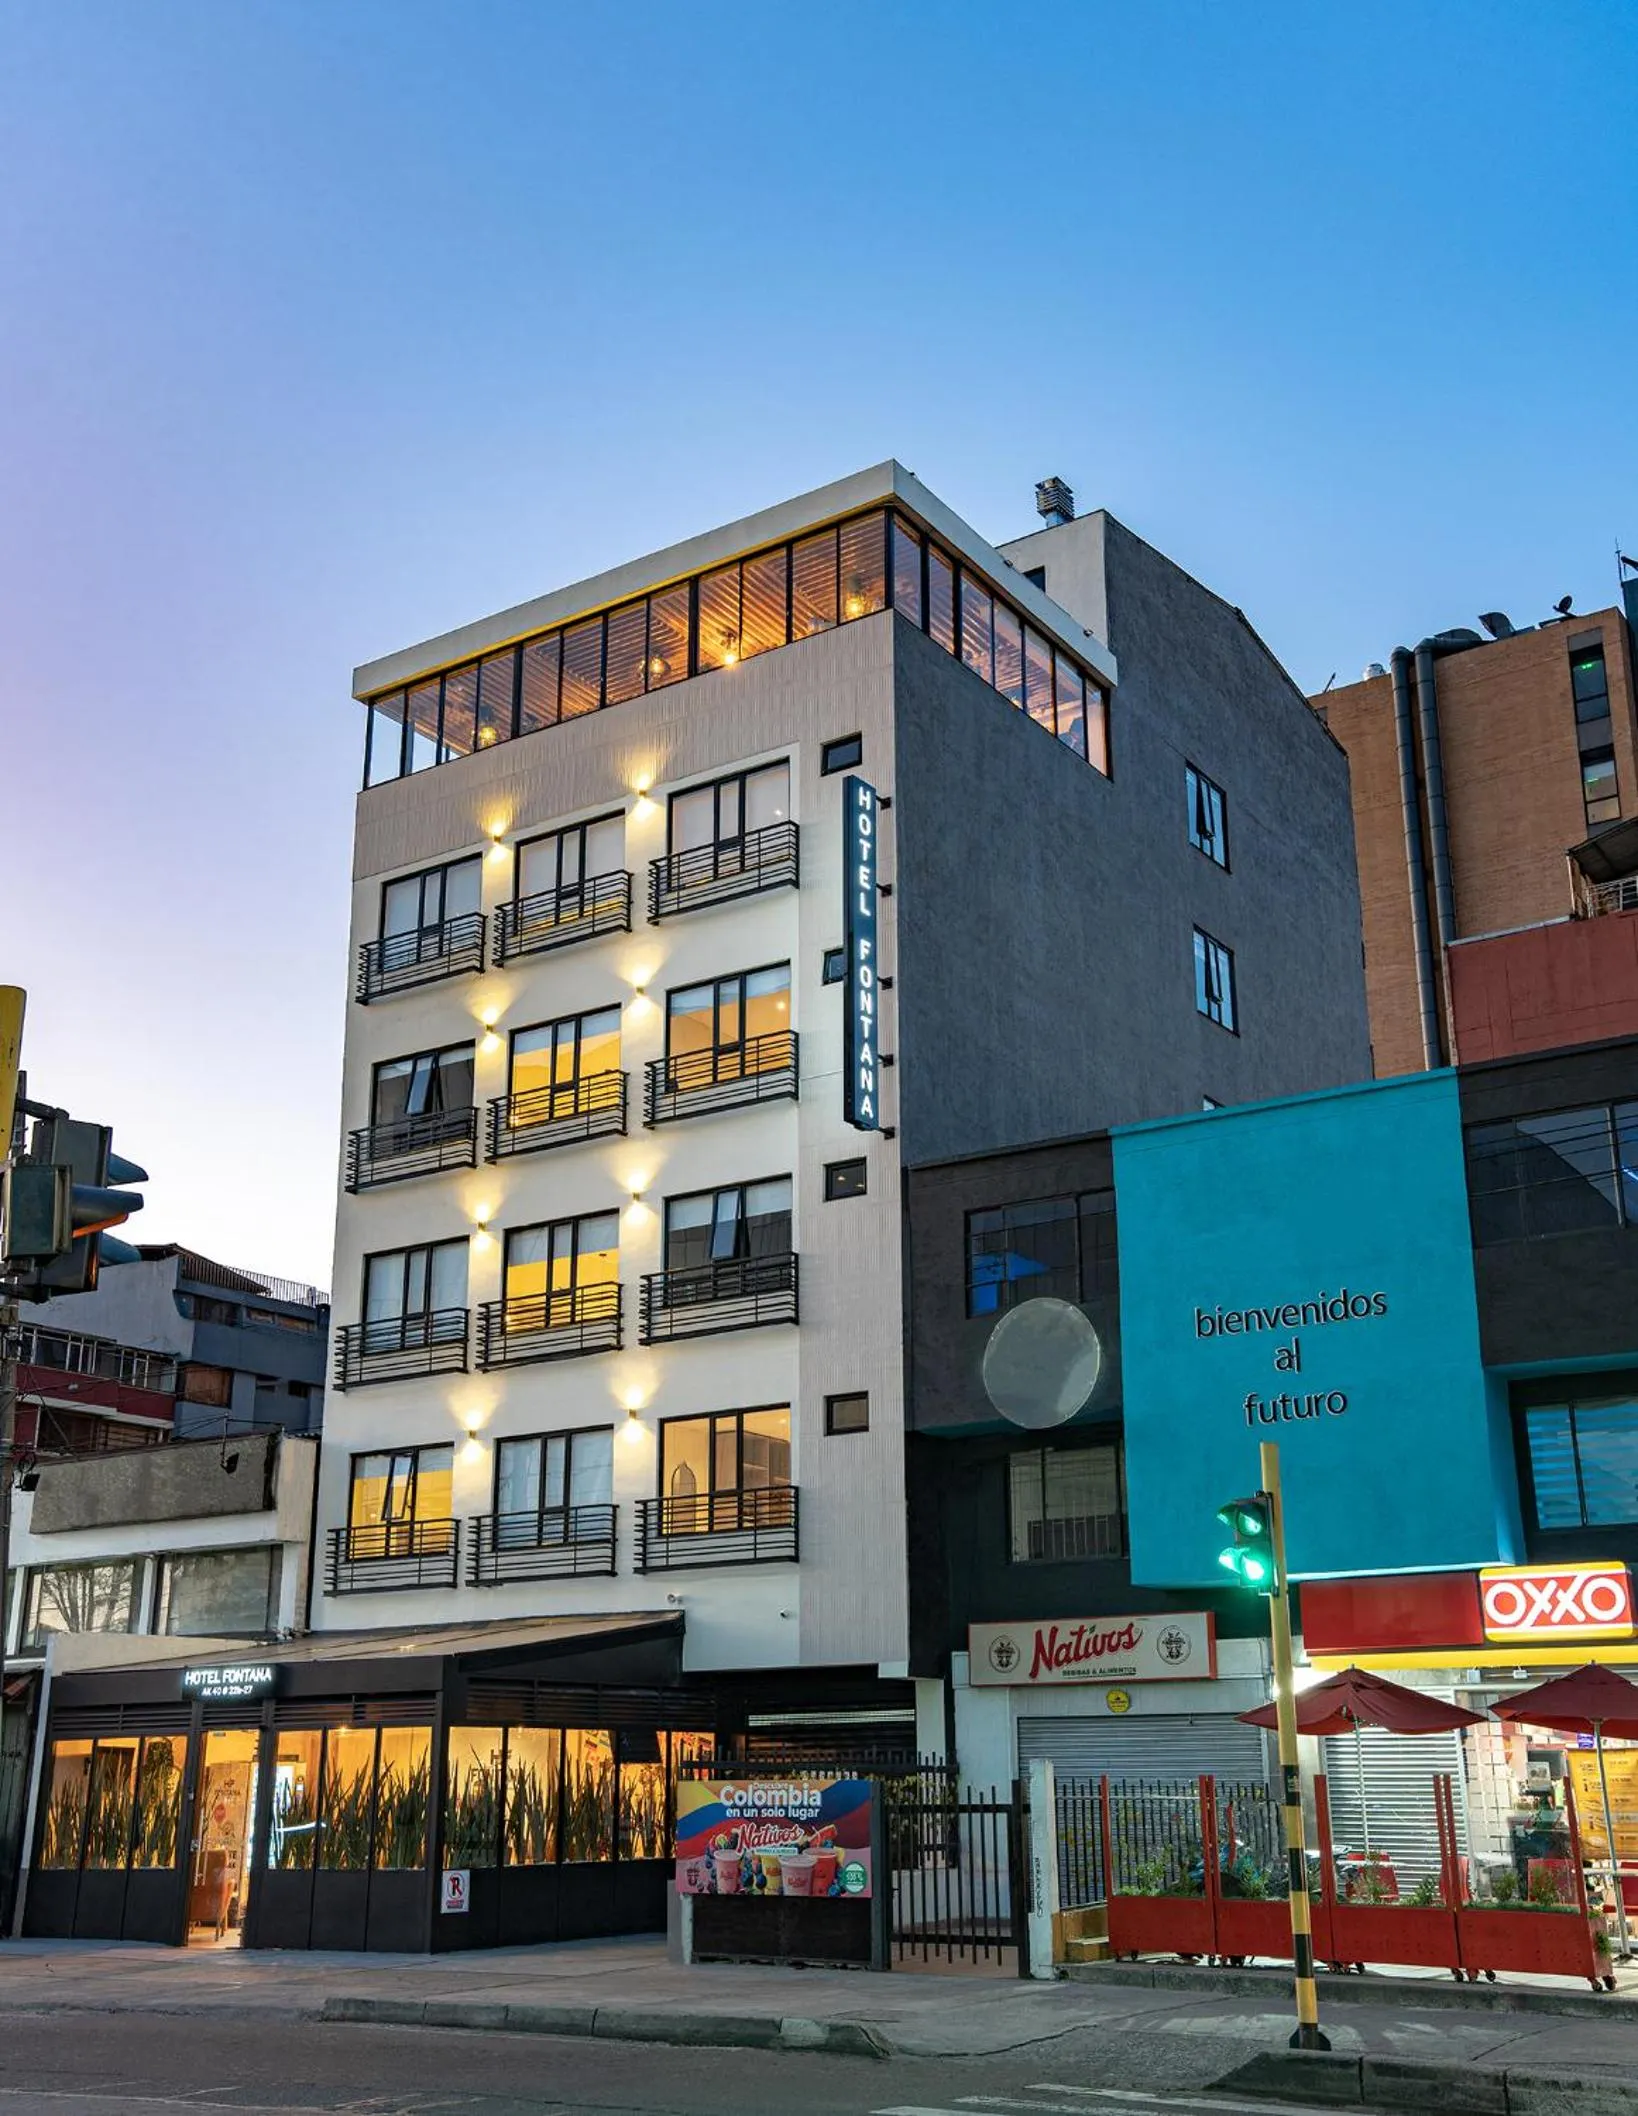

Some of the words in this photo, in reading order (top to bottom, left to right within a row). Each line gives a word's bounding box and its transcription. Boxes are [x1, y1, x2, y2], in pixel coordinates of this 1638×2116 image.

[858, 785, 872, 917] HOTEL
[859, 938, 874, 1119] FONTANA
[1194, 1287, 1389, 1340] bienvenidos
[1274, 1336, 1302, 1375] al
[1242, 1390, 1348, 1428] futuro
[1485, 1573, 1627, 1630] OXXO
[1028, 1621, 1144, 1679] Nativos
[184, 1669, 220, 1686] HOTEL
[222, 1667, 272, 1684] FONTANA
[720, 1783, 822, 1807] Colombia
[726, 1808, 740, 1818] en
[743, 1808, 758, 1818] un
[761, 1806, 786, 1818] solo
[788, 1806, 820, 1820] lugar
[735, 1822, 805, 1857] Nativos
